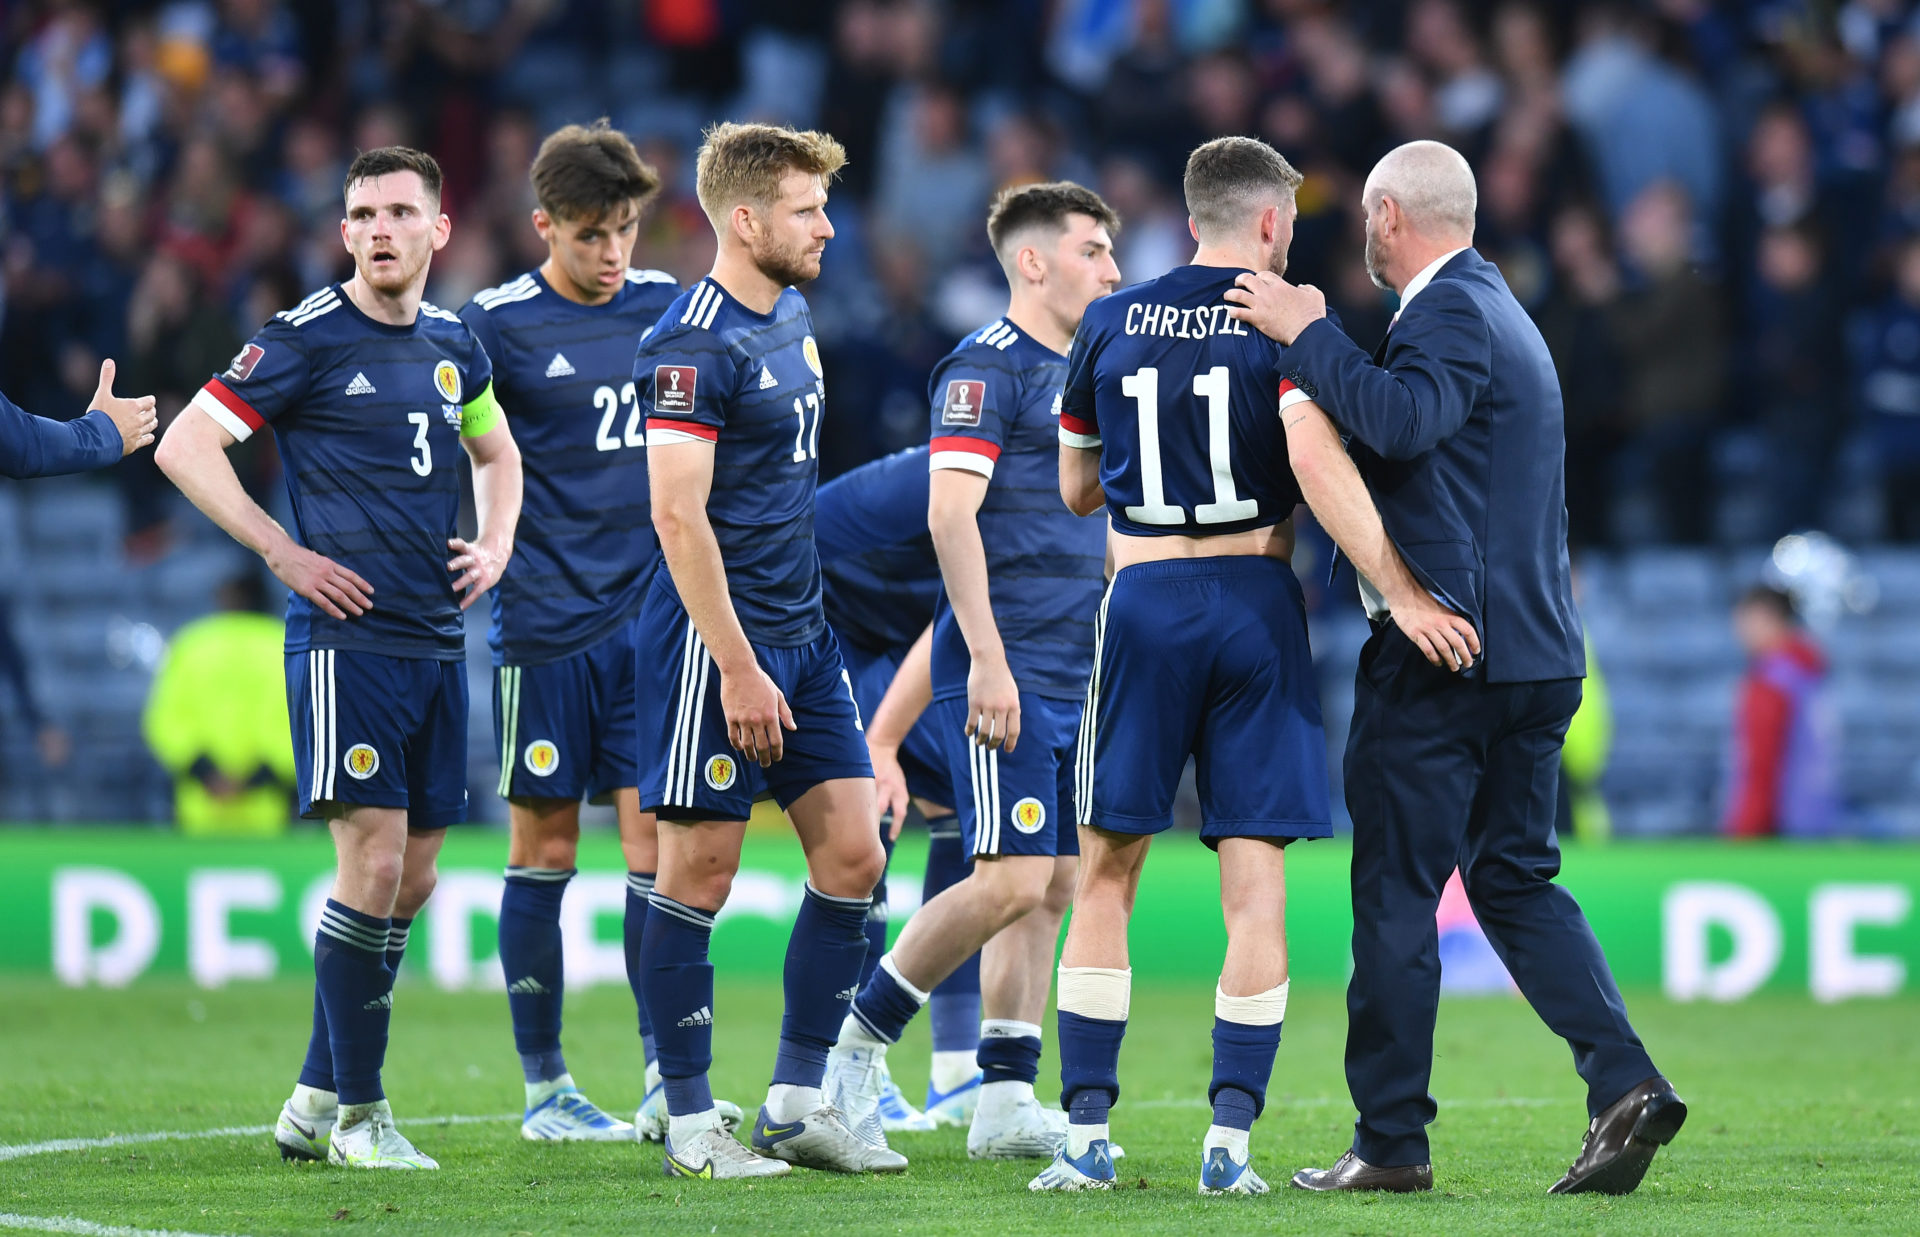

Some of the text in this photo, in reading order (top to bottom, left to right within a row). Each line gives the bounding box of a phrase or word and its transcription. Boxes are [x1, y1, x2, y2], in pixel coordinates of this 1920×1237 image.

[345, 385, 377, 396] adidas
[593, 382, 645, 451] 22
[407, 411, 433, 477] 3
[793, 392, 820, 463] 17
[1121, 366, 1259, 525] 11
